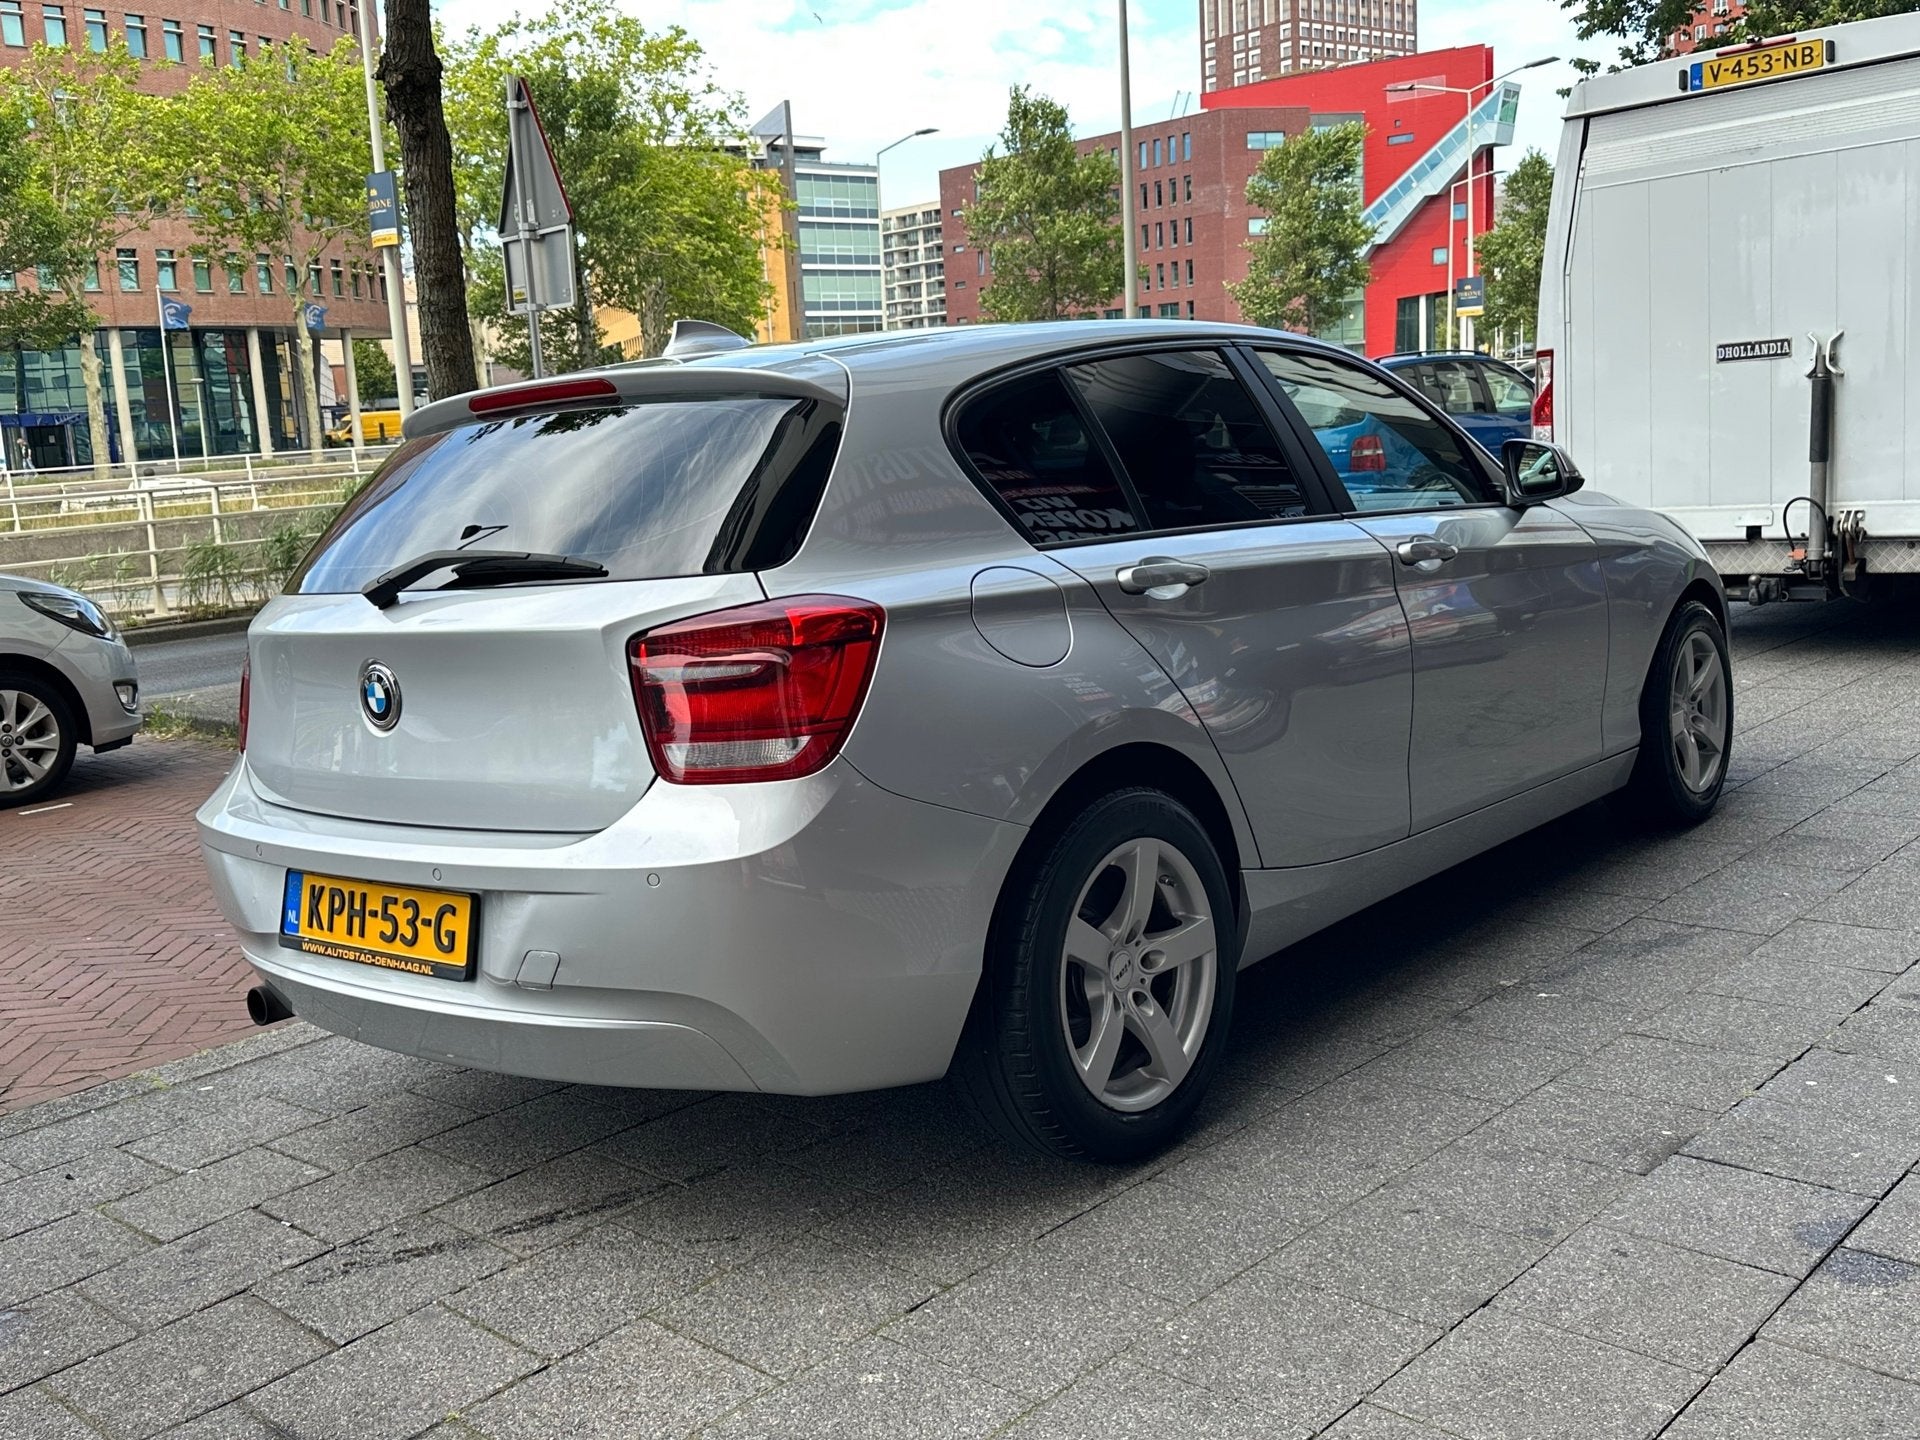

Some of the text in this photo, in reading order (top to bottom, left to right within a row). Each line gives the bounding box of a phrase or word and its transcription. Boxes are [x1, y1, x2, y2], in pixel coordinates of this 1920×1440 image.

[1708, 46, 1815, 83] V-453-NB
[1692, 79, 1702, 87] NL
[1717, 341, 1790, 359] DHOLLANDIA
[287, 909, 299, 924] NL
[306, 883, 457, 954] KPH-53-G
[301, 940, 435, 976] WWW.AUTOSTAD-DENHAAG.NL
